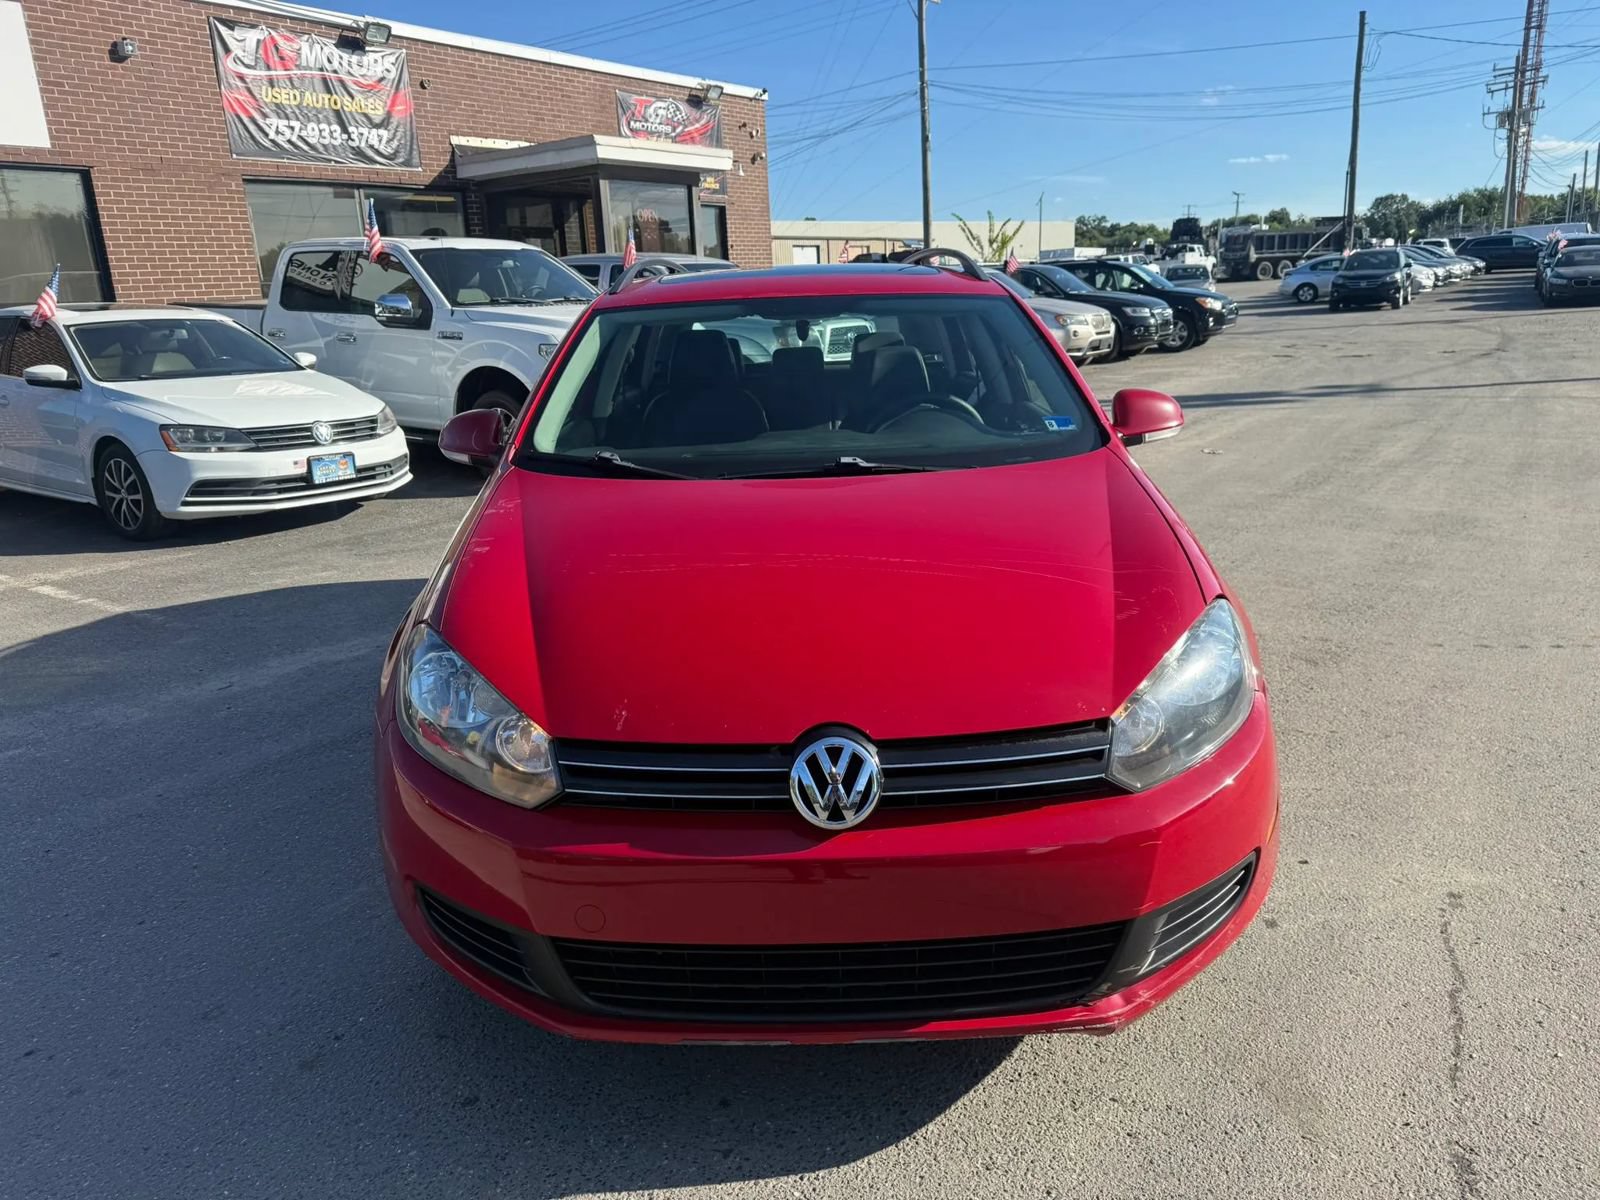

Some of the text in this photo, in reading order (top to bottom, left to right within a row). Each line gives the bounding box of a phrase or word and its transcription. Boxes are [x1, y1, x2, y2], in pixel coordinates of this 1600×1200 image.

[301, 41, 397, 79] MOTORS
[262, 86, 385, 115] USED AUTO SALES
[265, 118, 389, 148] 757-933-3747
[630, 120, 672, 133] MOTORS
[637, 208, 659, 222] OPEN
[790, 737, 881, 830] VW
